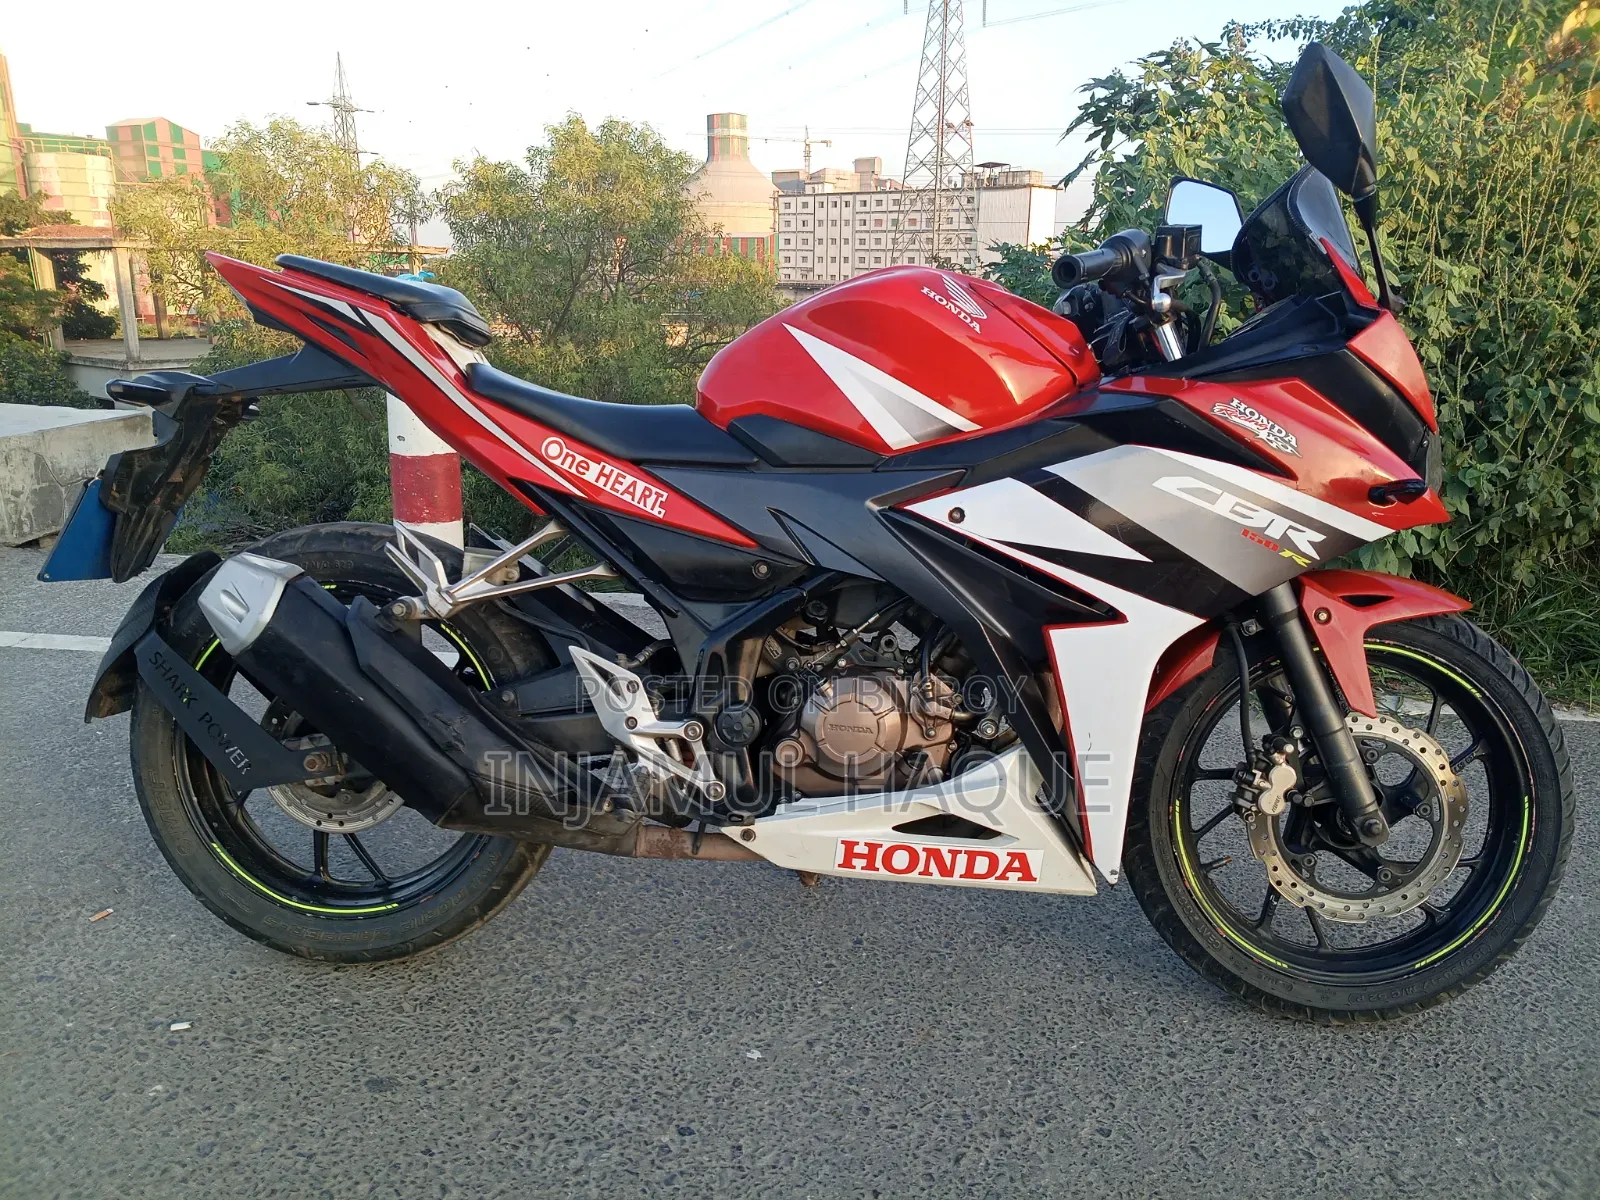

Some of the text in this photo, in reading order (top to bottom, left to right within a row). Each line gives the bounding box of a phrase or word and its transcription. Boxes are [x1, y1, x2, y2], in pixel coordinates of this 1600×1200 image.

[921, 286, 981, 334] HONDA
[1215, 404, 1269, 431] Racing
[1230, 397, 1298, 447] HONDA
[544, 439, 664, 515] One HEART.
[1152, 476, 1327, 561] CBR
[149, 651, 252, 775] SHARK POWER
[828, 723, 874, 734] HONDA
[837, 839, 1038, 882] HONDA
